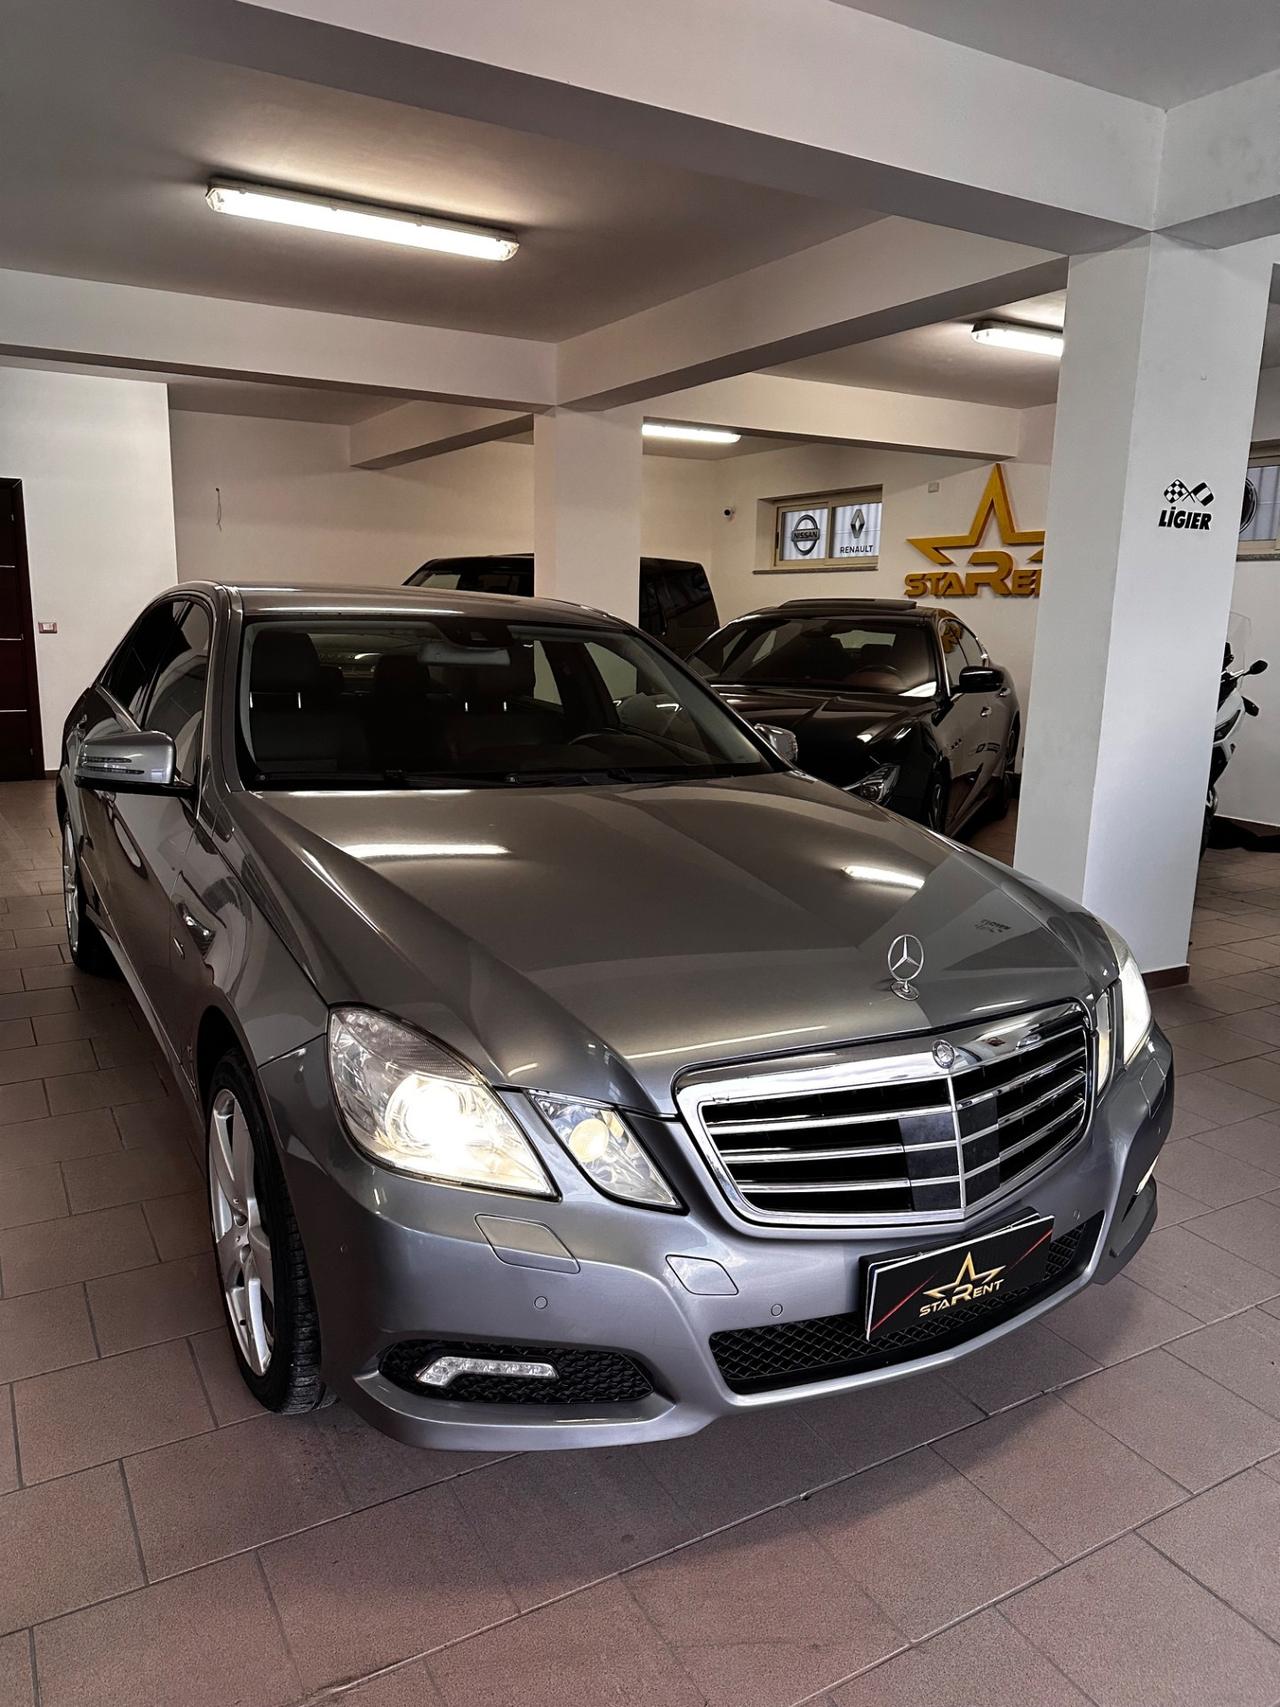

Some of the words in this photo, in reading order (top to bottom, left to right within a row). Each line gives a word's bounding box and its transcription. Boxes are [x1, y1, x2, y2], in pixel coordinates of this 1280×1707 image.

[793, 531, 818, 539] NISSAN
[840, 545, 873, 554] RENAULT
[919, 1279, 1005, 1317] STARENT
